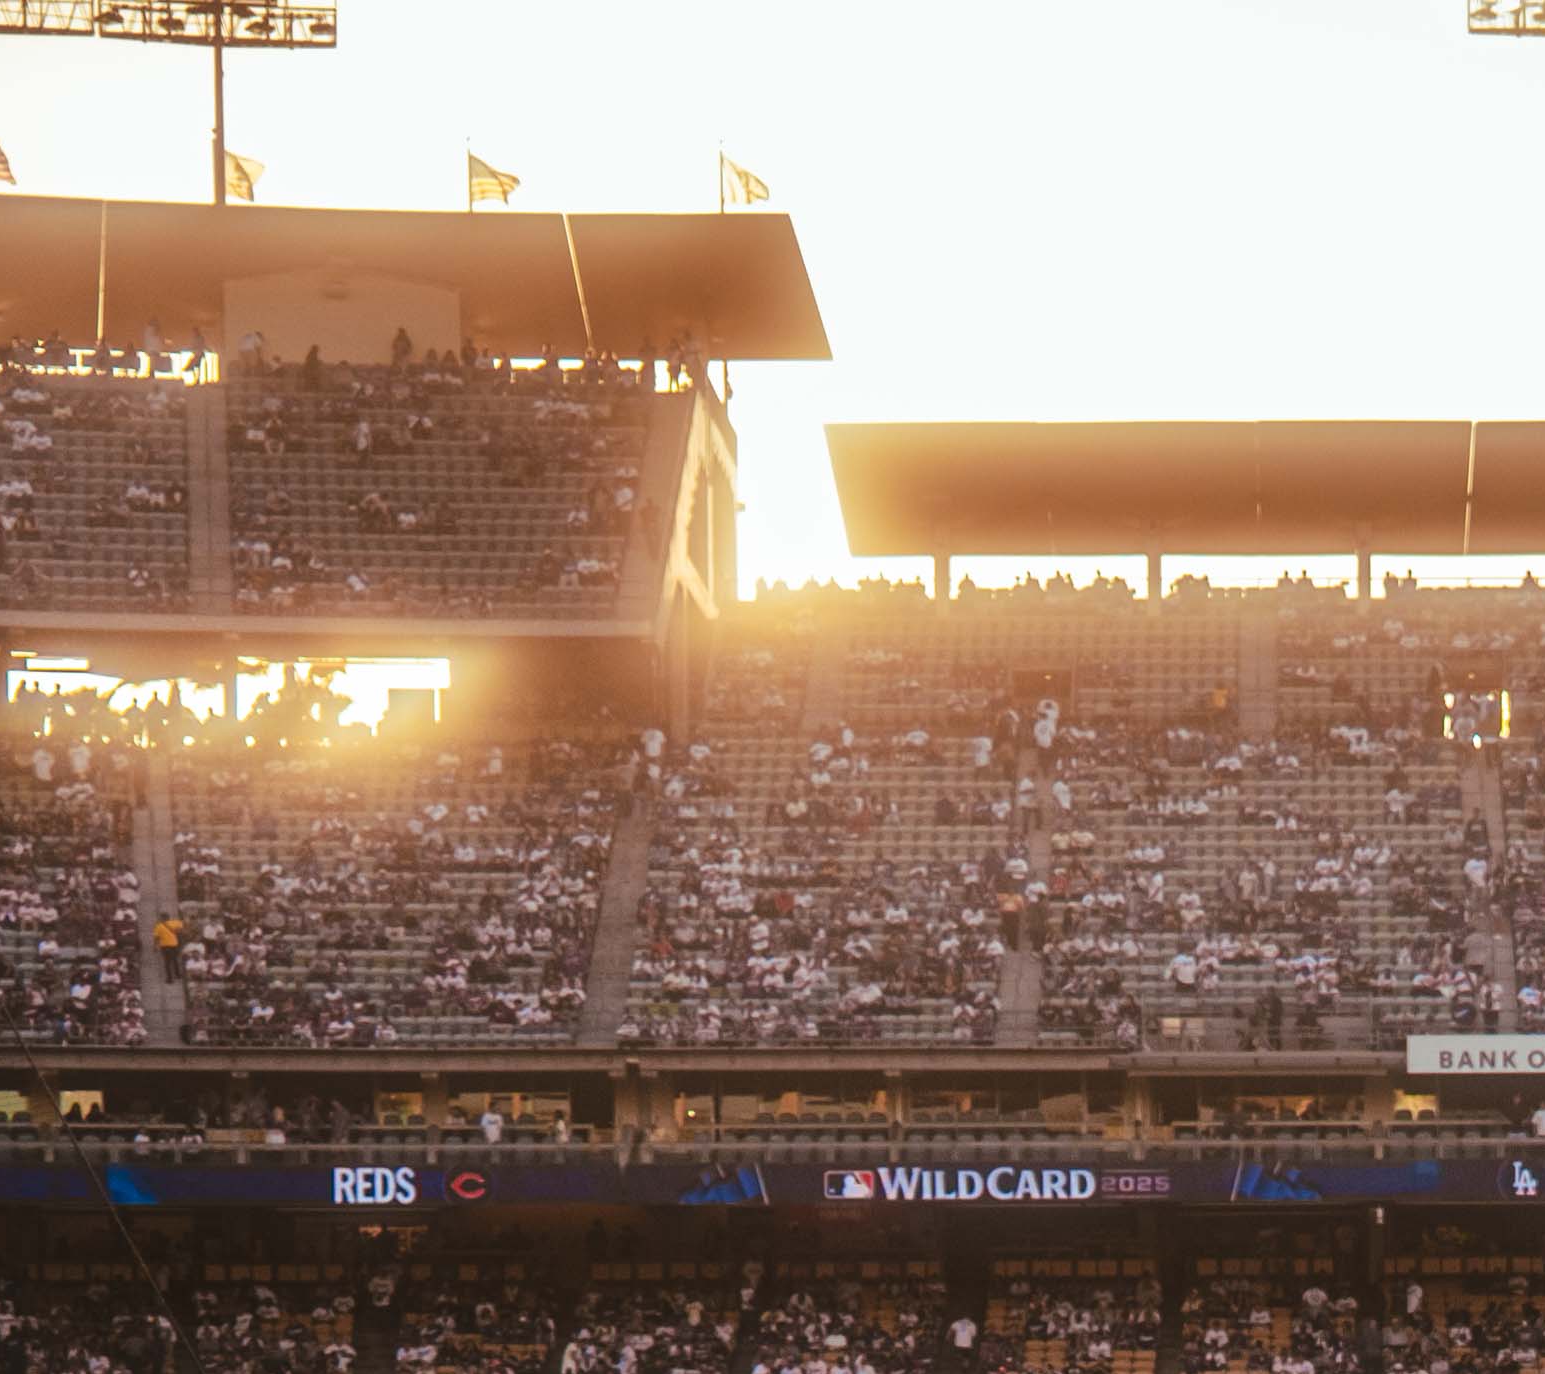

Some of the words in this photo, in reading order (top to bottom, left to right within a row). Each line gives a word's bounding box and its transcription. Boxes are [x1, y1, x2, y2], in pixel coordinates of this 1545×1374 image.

[1439, 1050, 1517, 1070] BANK
[332, 1166, 416, 1205] REDS
[1101, 1174, 1171, 1193] 2025
